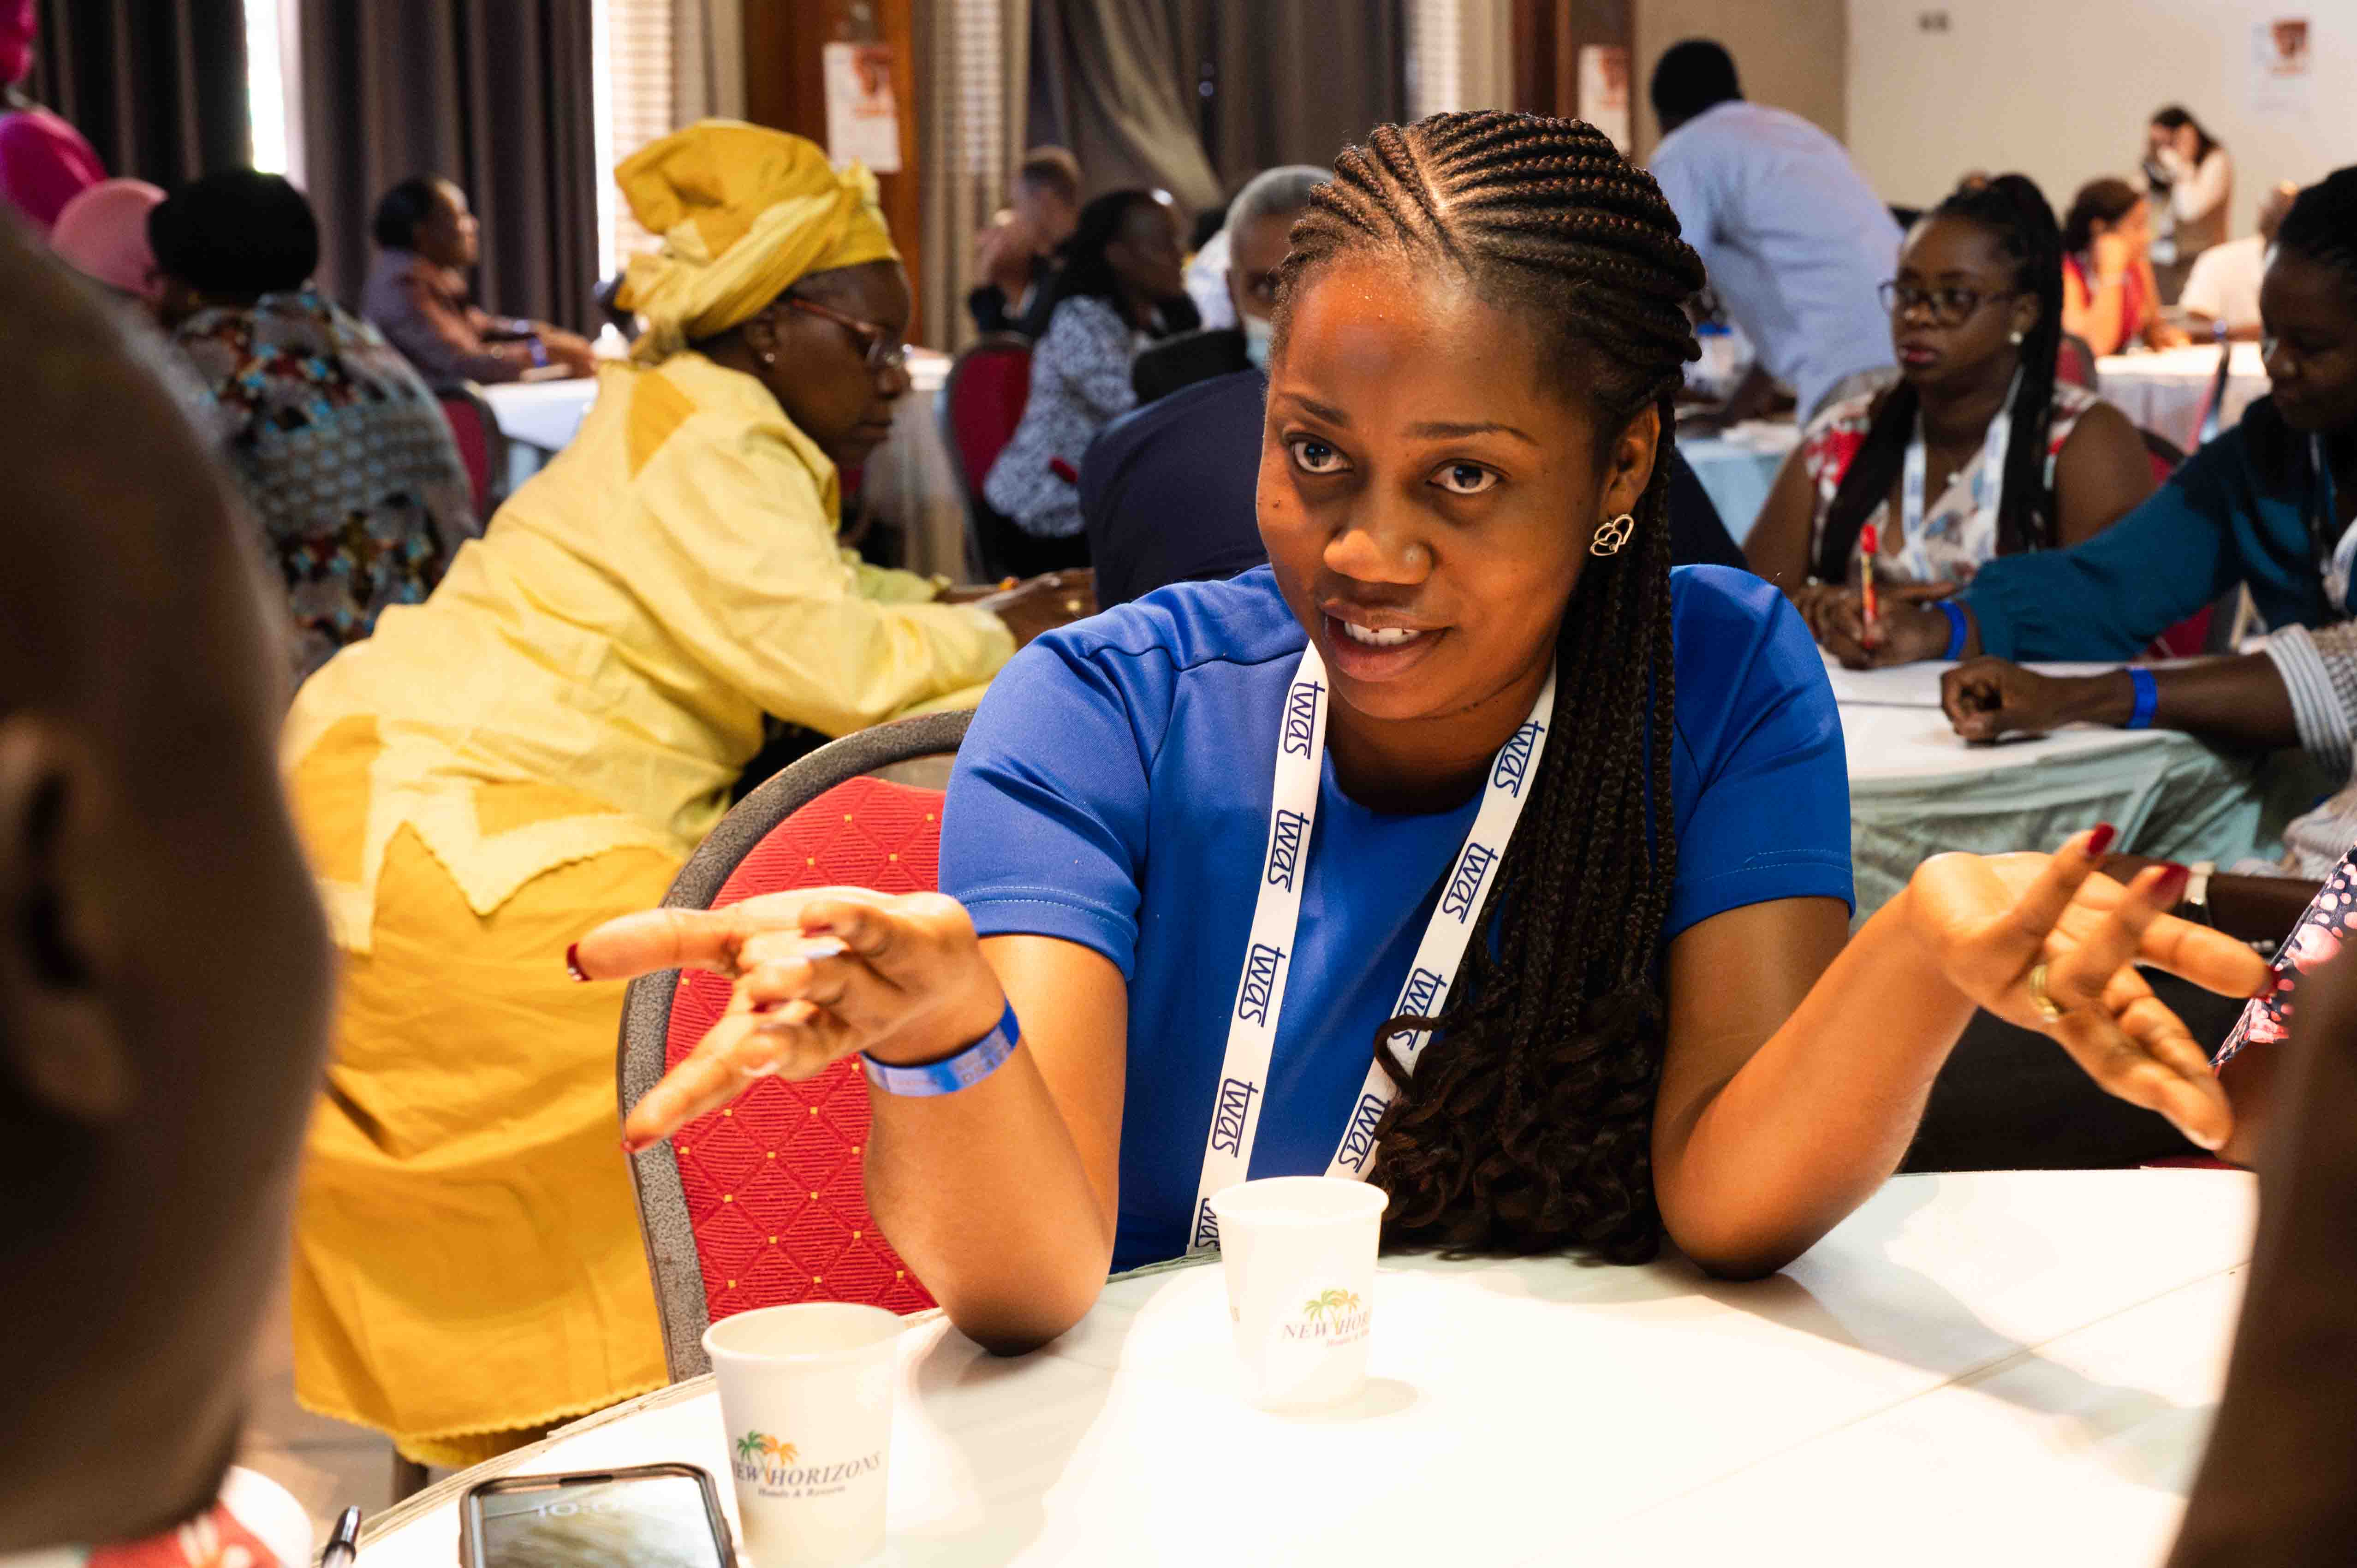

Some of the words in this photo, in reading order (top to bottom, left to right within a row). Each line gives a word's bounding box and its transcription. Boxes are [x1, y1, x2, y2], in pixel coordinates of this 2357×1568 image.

[1284, 681, 1325, 760] twas
[1494, 720, 1545, 798] twas
[1268, 809, 1310, 893] twas
[1442, 842, 1499, 924] twas
[1238, 943, 1286, 1028] twas
[1212, 1078, 1259, 1158] twas
[1338, 1093, 1391, 1174] twas
[1194, 1198, 1221, 1251] was
[1283, 1322, 1328, 1339] NEW
